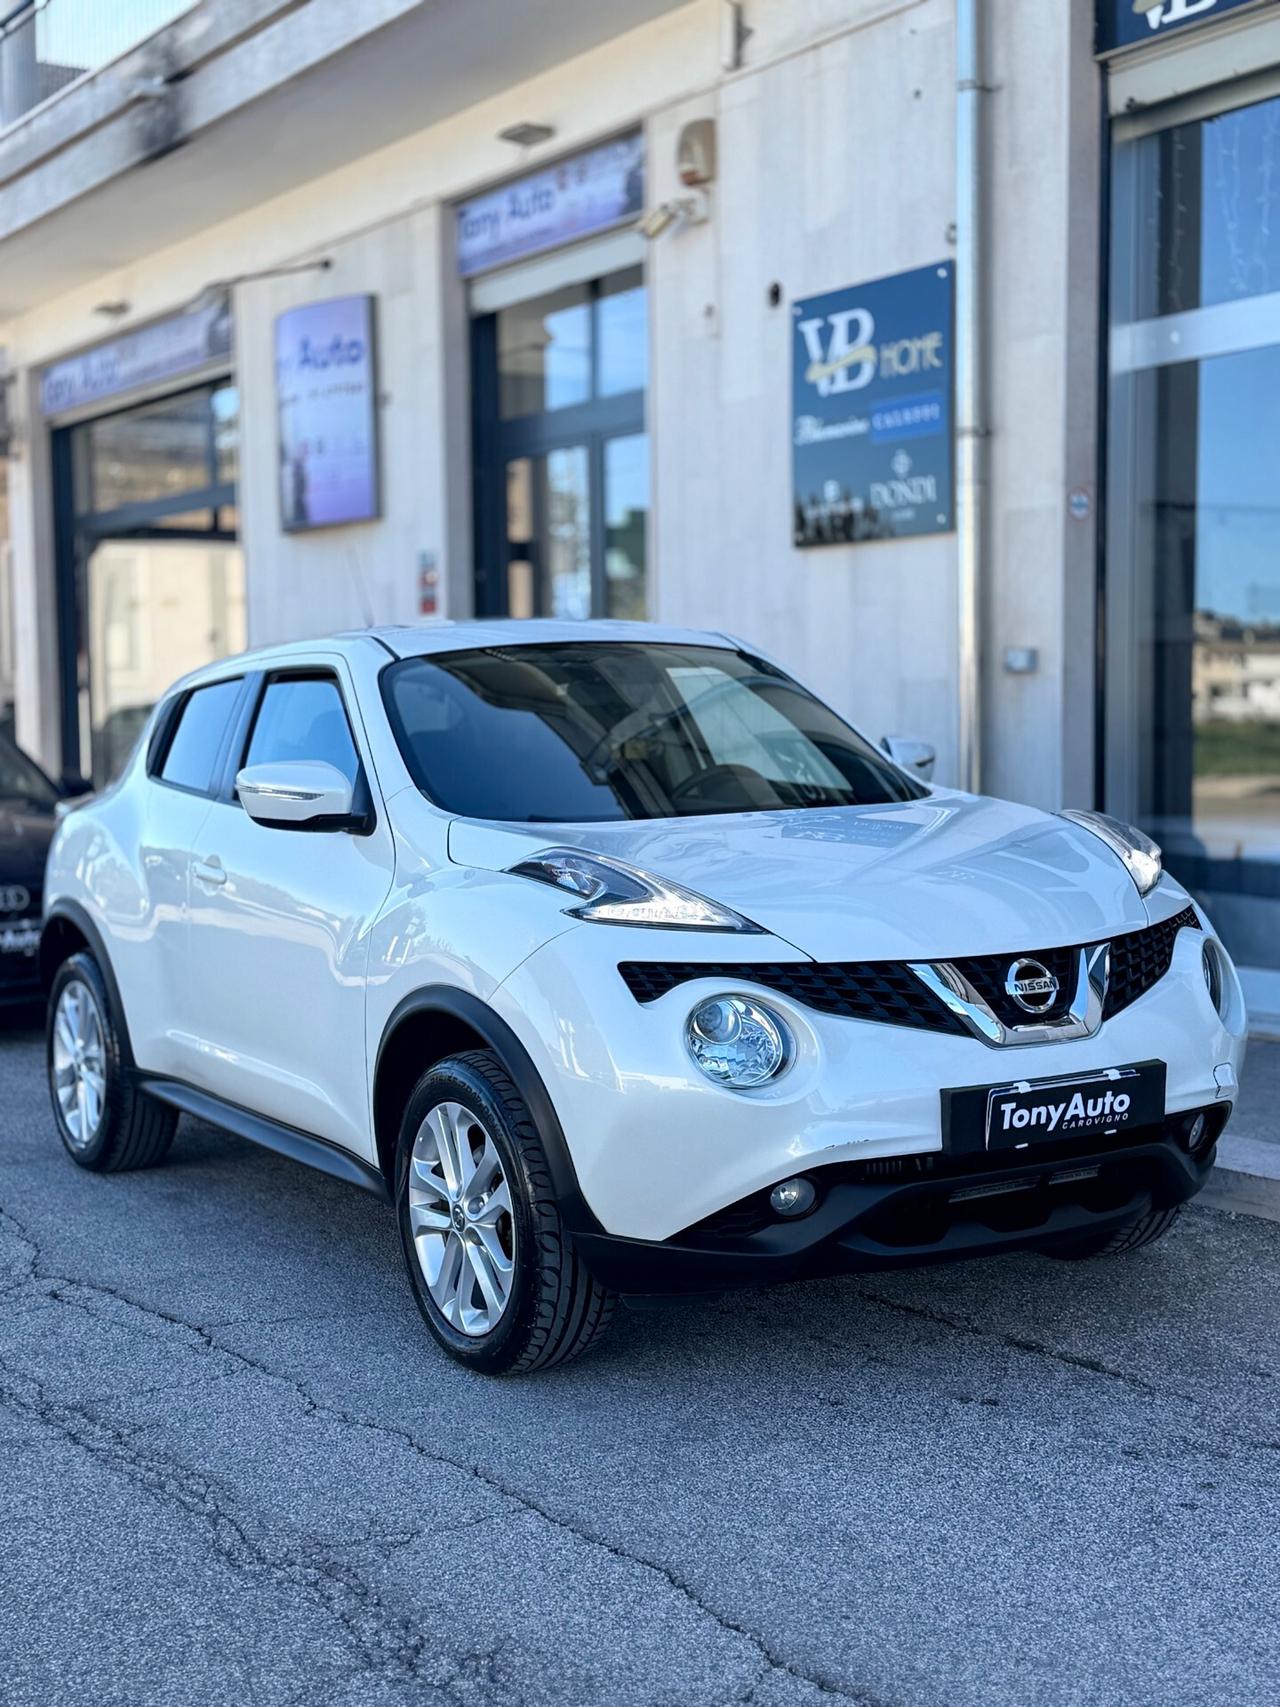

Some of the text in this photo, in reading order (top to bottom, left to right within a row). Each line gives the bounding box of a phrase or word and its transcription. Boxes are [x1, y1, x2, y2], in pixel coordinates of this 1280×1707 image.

[507, 187, 554, 219] Auto
[298, 335, 364, 369] Auto
[797, 307, 944, 398] VB HOME
[1013, 979, 1057, 992] NISSAN
[1001, 1090, 1131, 1132] TonyAuto
[1062, 1112, 1129, 1130] CAROVIGNO
